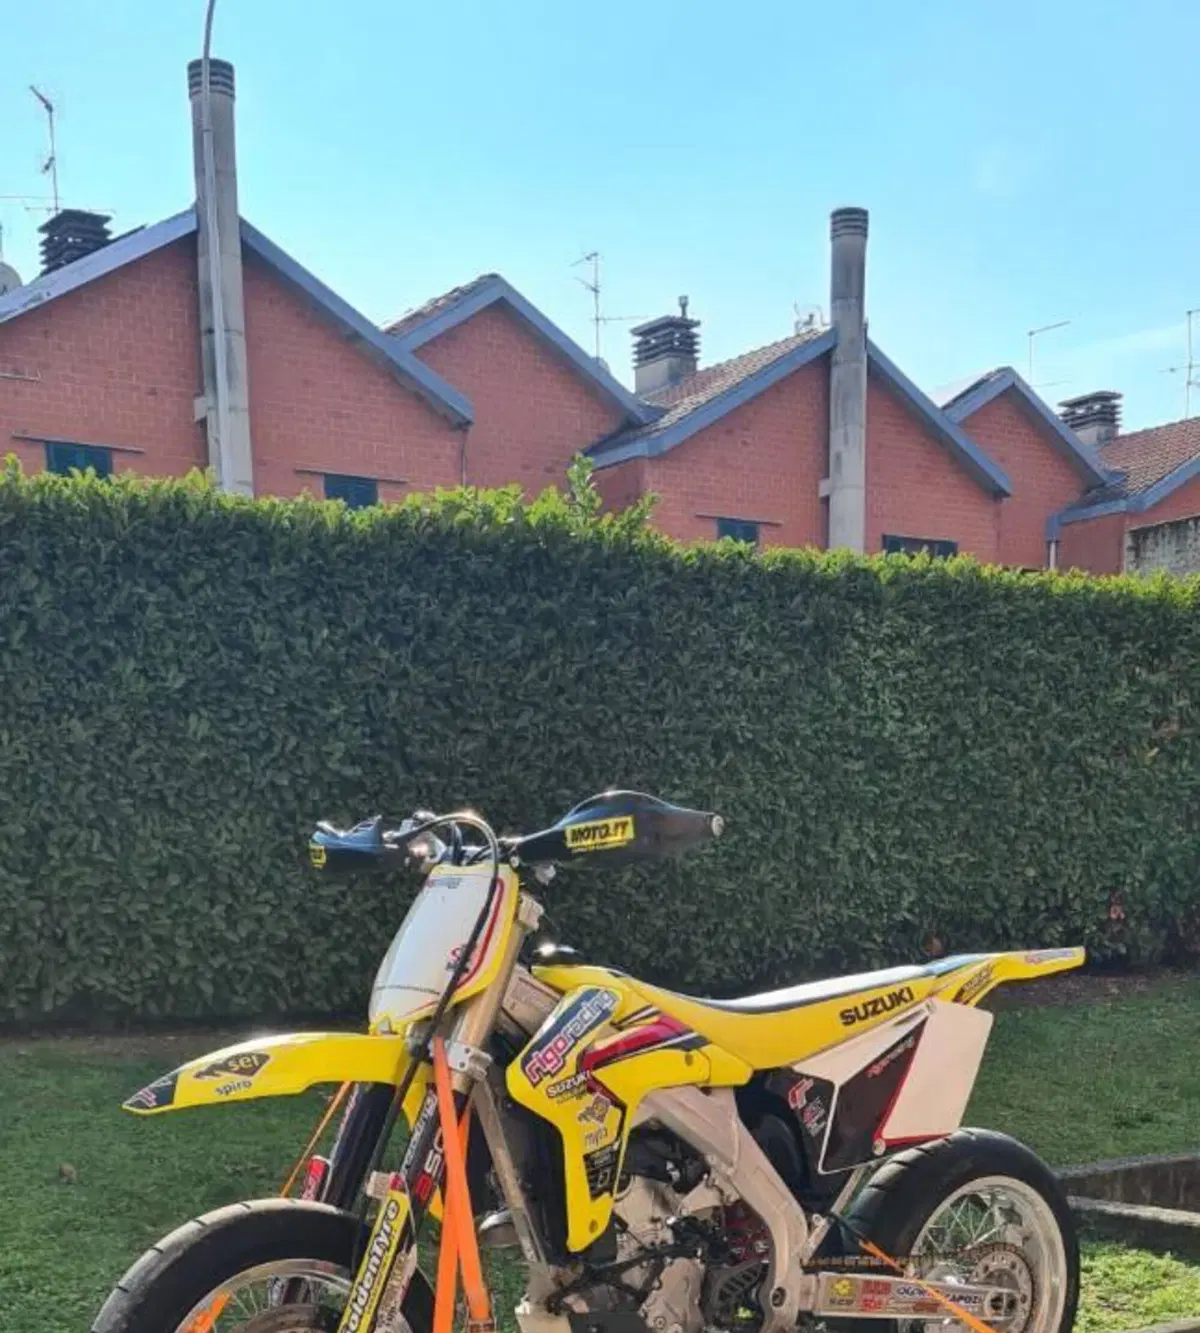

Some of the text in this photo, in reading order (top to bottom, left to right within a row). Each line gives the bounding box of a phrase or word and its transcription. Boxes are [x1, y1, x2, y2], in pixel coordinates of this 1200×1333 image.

[570, 819, 630, 844] MOTO.IT
[839, 986, 915, 1026] SUZUKI
[524, 987, 617, 1088] rigoracing
